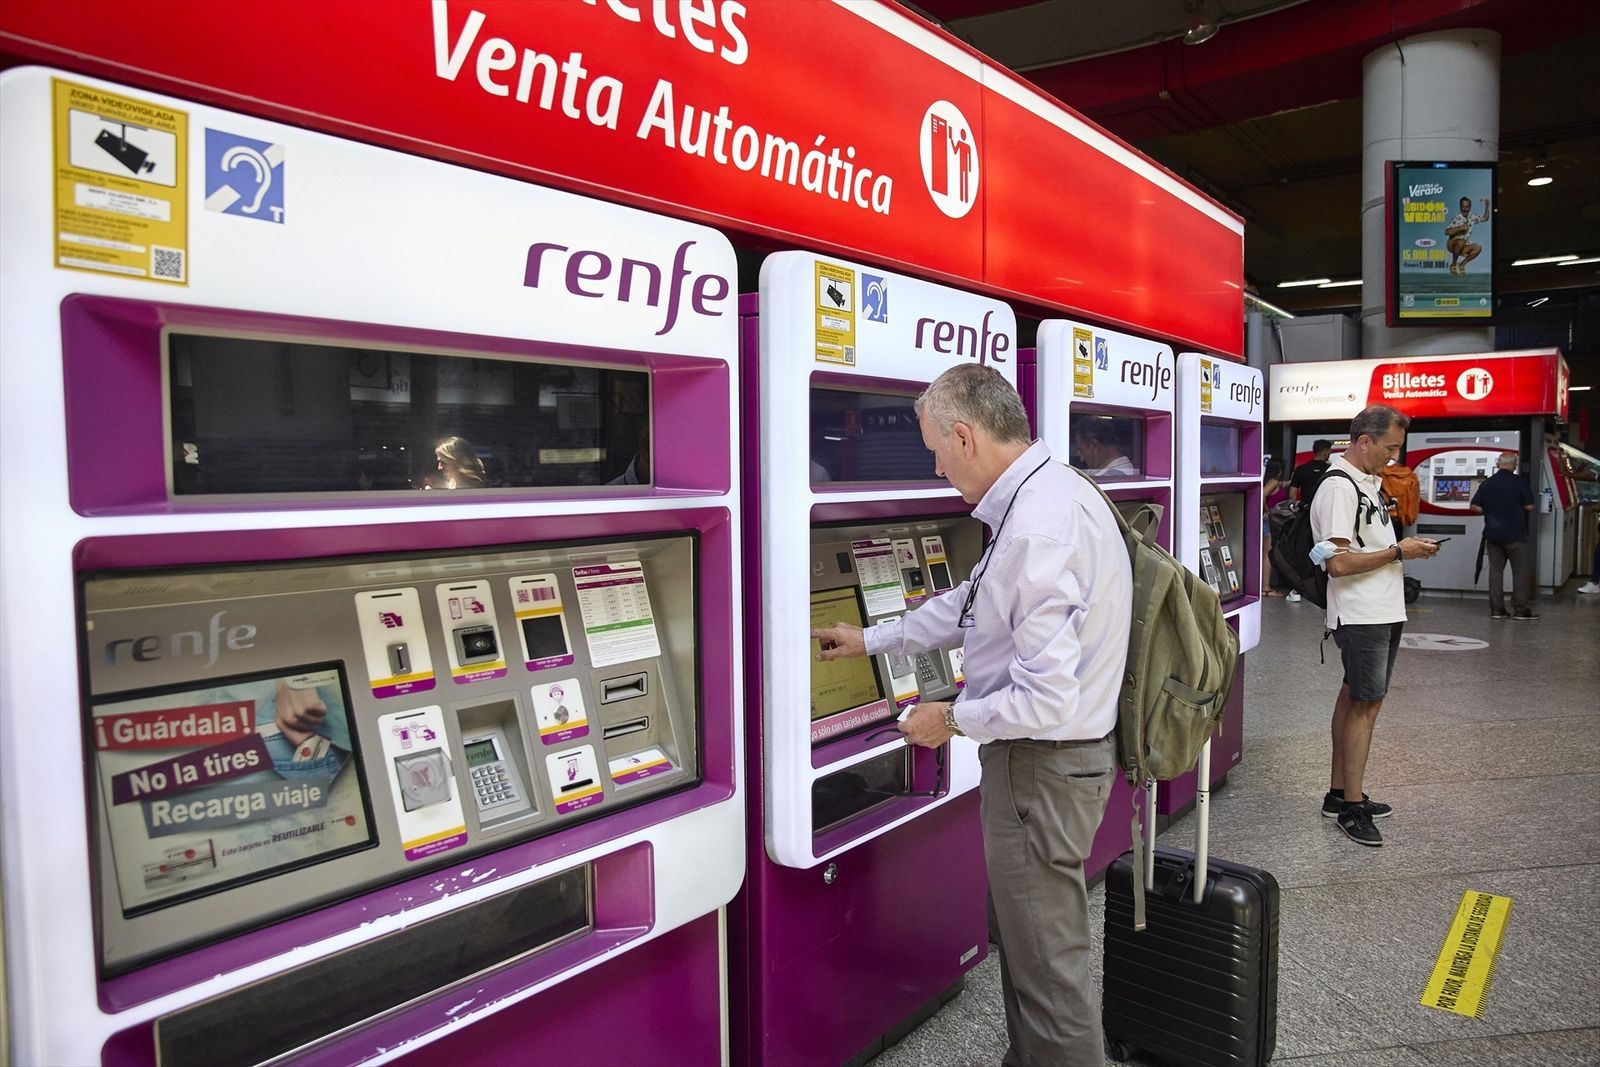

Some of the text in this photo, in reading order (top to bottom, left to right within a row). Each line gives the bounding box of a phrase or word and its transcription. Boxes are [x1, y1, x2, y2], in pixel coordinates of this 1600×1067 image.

[70, 89, 176, 121] ZONA VIDEOVIGILADA
[432, 0, 893, 216] Venta Automática
[1408, 184, 1443, 198] Verano
[523, 241, 729, 336] renfe
[915, 311, 1009, 364] renfe
[1121, 352, 1171, 401] renfe
[1230, 375, 1261, 414] renfe
[1382, 372, 1446, 389] Billetes
[1383, 388, 1448, 399] Venta Automática
[103, 611, 258, 670] renfe
[818, 725, 830, 737] sólo
[831, 723, 842, 732] con
[842, 716, 861, 729] tarjeta
[861, 712, 869, 720] de
[869, 707, 888, 719] crédito
[129, 749, 260, 796] No la tires
[151, 784, 321, 827] Recarga viaje
[222, 848, 236, 857] Este
[239, 842, 261, 852] tarjeta
[271, 822, 326, 843] REUTILIZABLE
[1437, 994, 1456, 1010] POR
